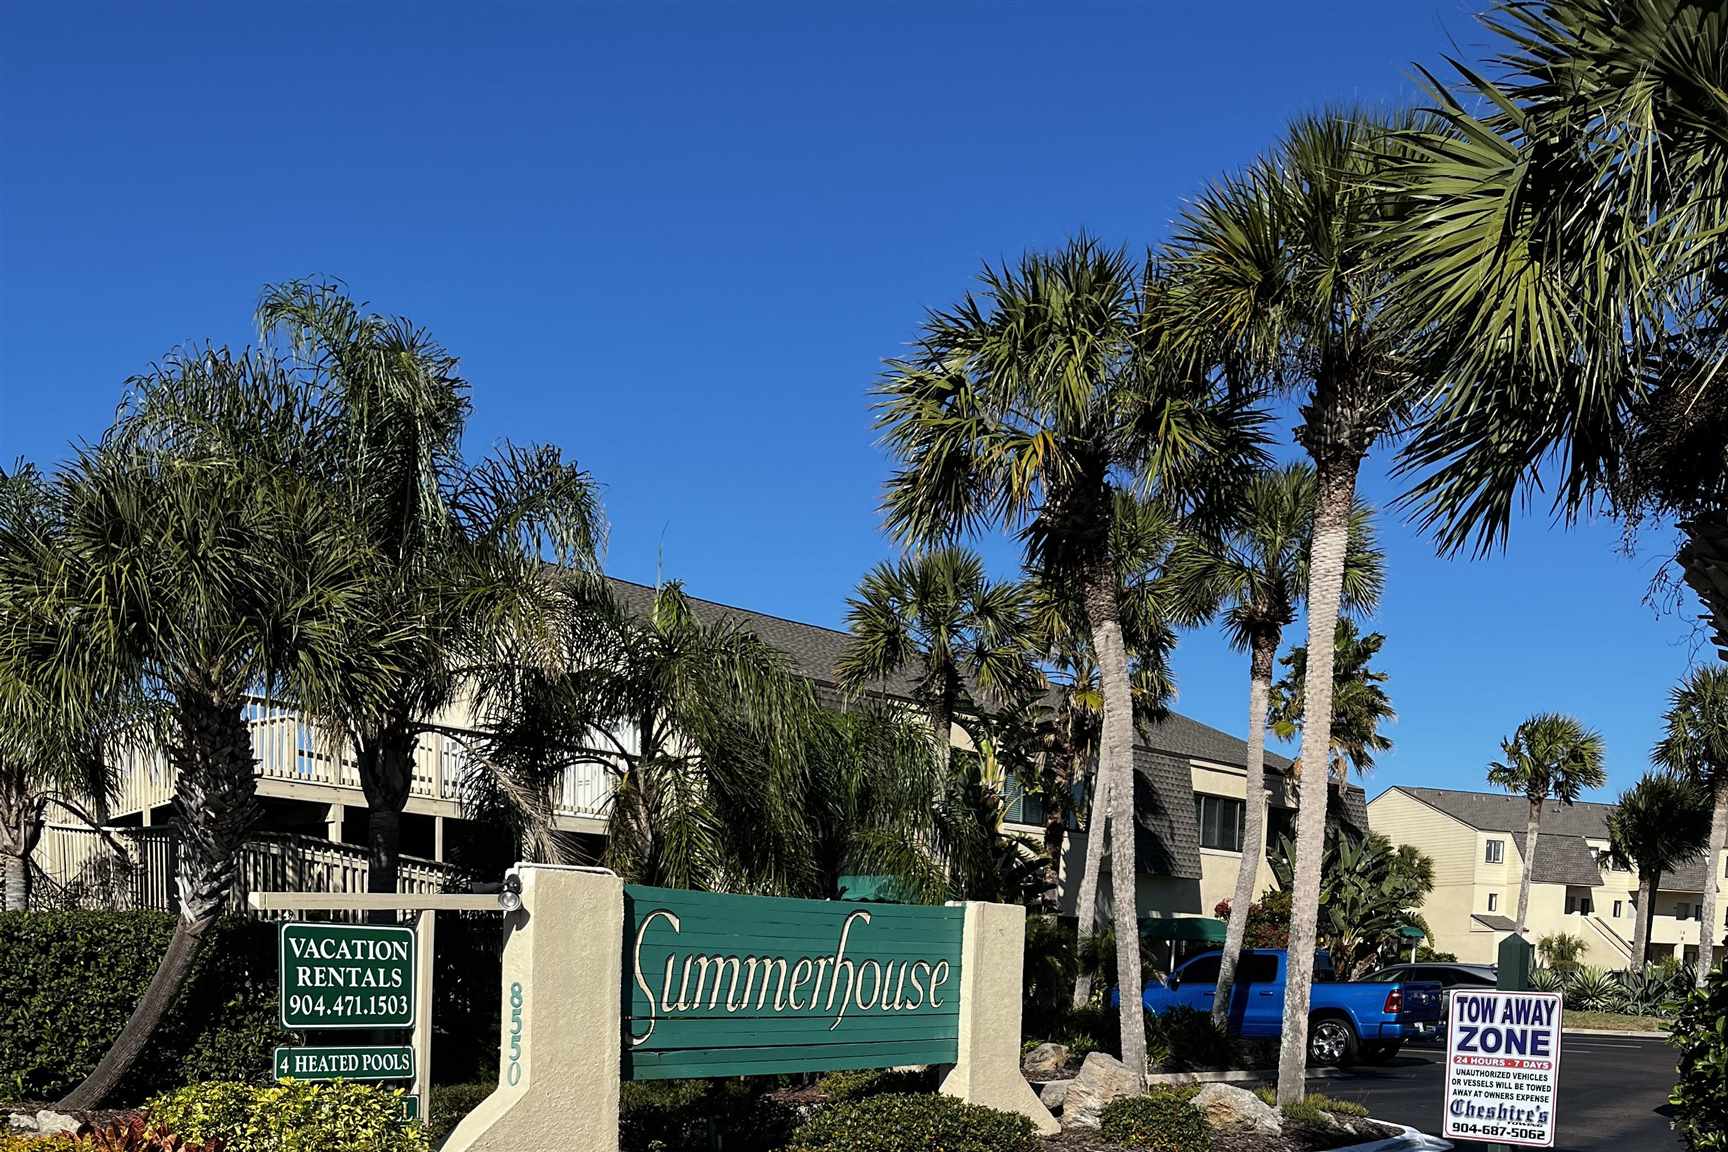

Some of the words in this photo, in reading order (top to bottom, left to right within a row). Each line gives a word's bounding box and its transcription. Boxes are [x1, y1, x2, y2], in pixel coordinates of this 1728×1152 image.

[288, 937, 409, 961] VACATION
[297, 966, 402, 988] RENTALS
[625, 908, 949, 1046] Summerhouse
[289, 994, 408, 1016] 904.471.1503
[1456, 996, 1497, 1024] TOW
[1501, 998, 1556, 1026] AWAY
[507, 981, 523, 1087] 8550
[1457, 1026, 1551, 1057] ZONE
[280, 1056, 289, 1073] 4
[295, 1055, 359, 1073] HEATED
[363, 1053, 410, 1071] POOLS
[1456, 1056, 1468, 1064] 24
[1470, 1057, 1505, 1066] HOURS
[1524, 1061, 1550, 1069] DAYS
[1451, 1078, 1461, 1086] OR
[1463, 1079, 1494, 1089] VESSELS
[1495, 1082, 1512, 1090] WILL
[1514, 1083, 1524, 1091] BE
[1526, 1084, 1552, 1093] TOWED
[1456, 1068, 1511, 1079] UNAUTHORIZED
[1512, 1072, 1548, 1082] VEHICLES
[1452, 1088, 1472, 1097] AWAY
[1473, 1090, 1482, 1098] AT
[1484, 1091, 1514, 1100] OWNERS
[1516, 1093, 1550, 1103] EXPENSE
[1450, 1099, 1549, 1125] Cheshire's
[1452, 1122, 1546, 1140] 904-687-5062
